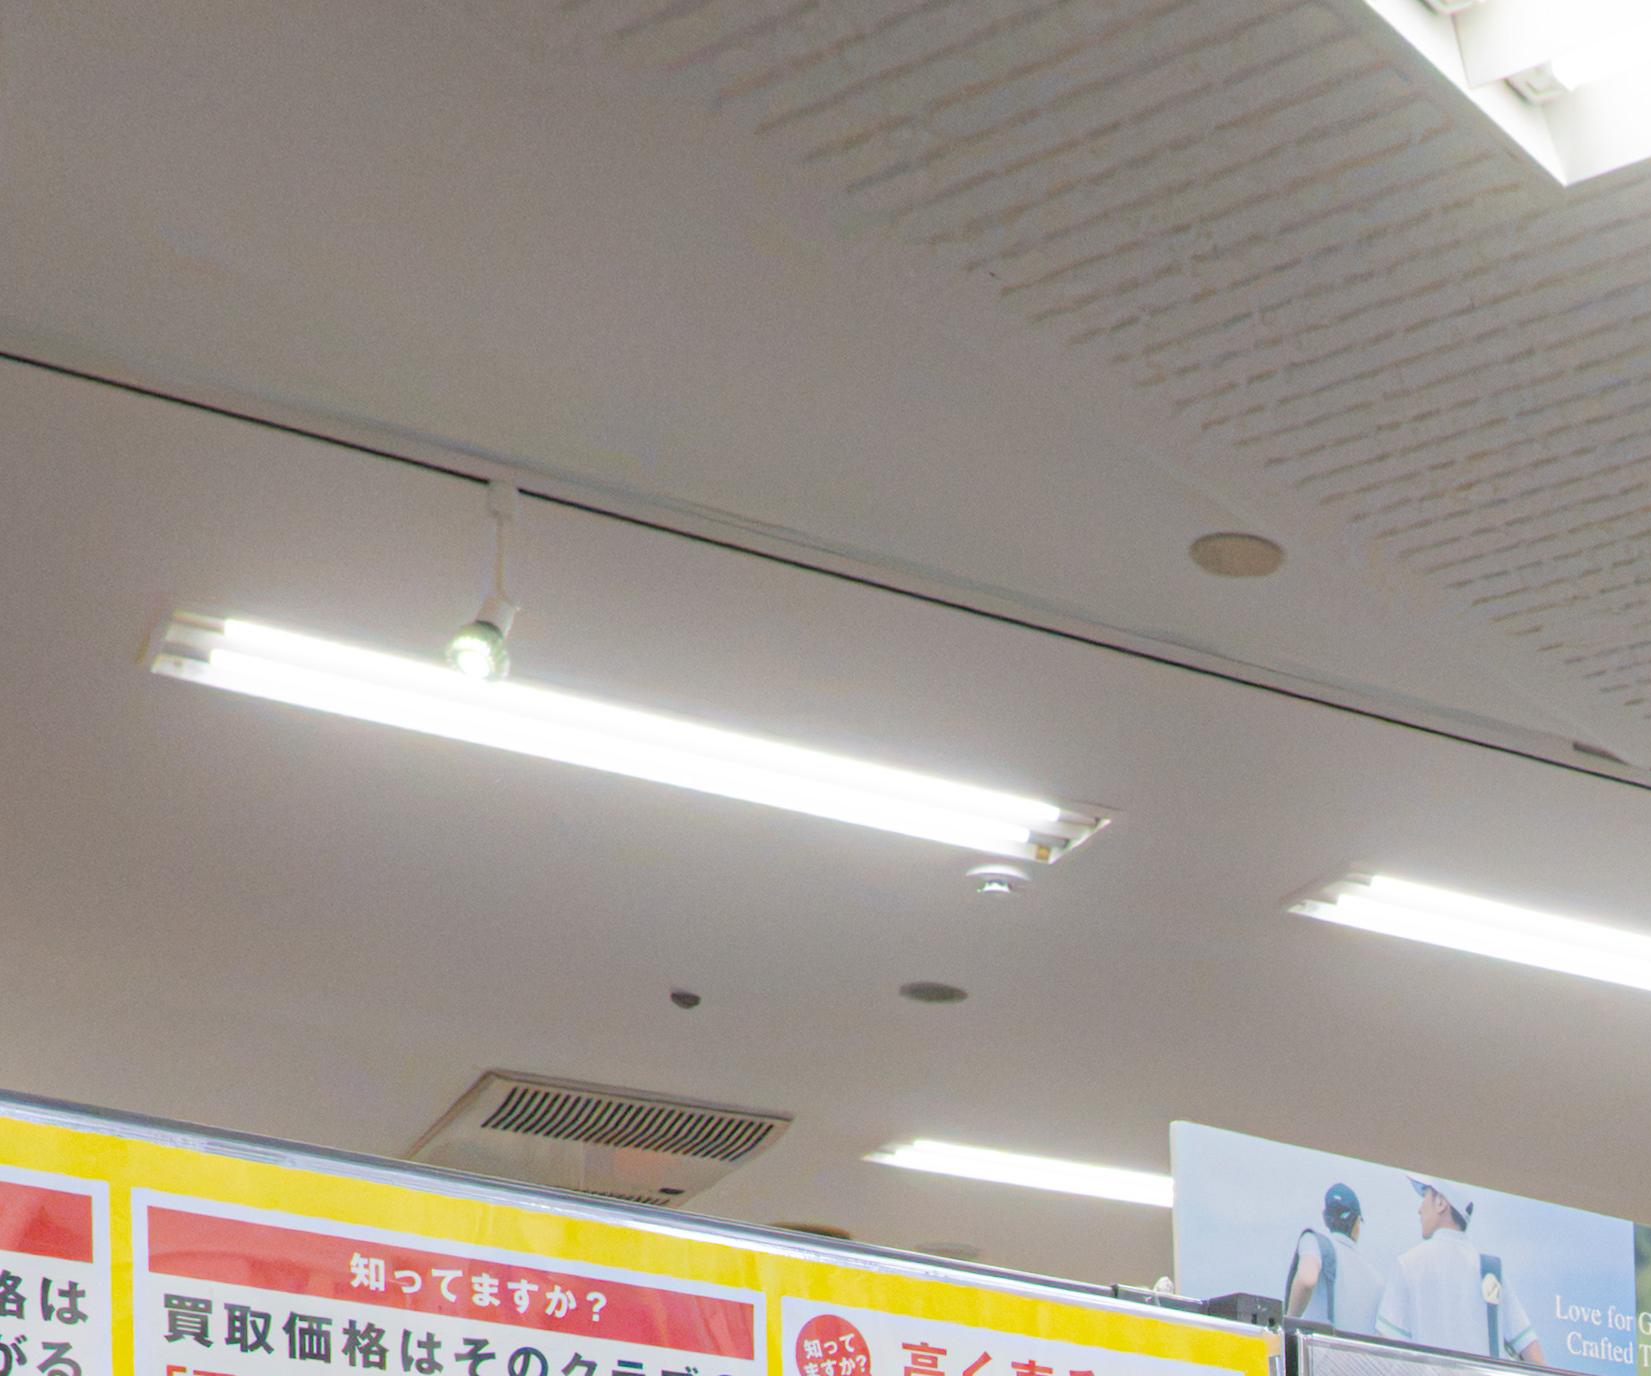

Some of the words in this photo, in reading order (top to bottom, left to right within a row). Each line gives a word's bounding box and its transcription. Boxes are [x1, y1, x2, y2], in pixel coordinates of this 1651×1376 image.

[1556, 1296, 1603, 1322] Love
[1607, 1305, 1633, 1331] for
[804, 1335, 855, 1360] 知って
[1567, 1333, 1633, 1364] Crafted
